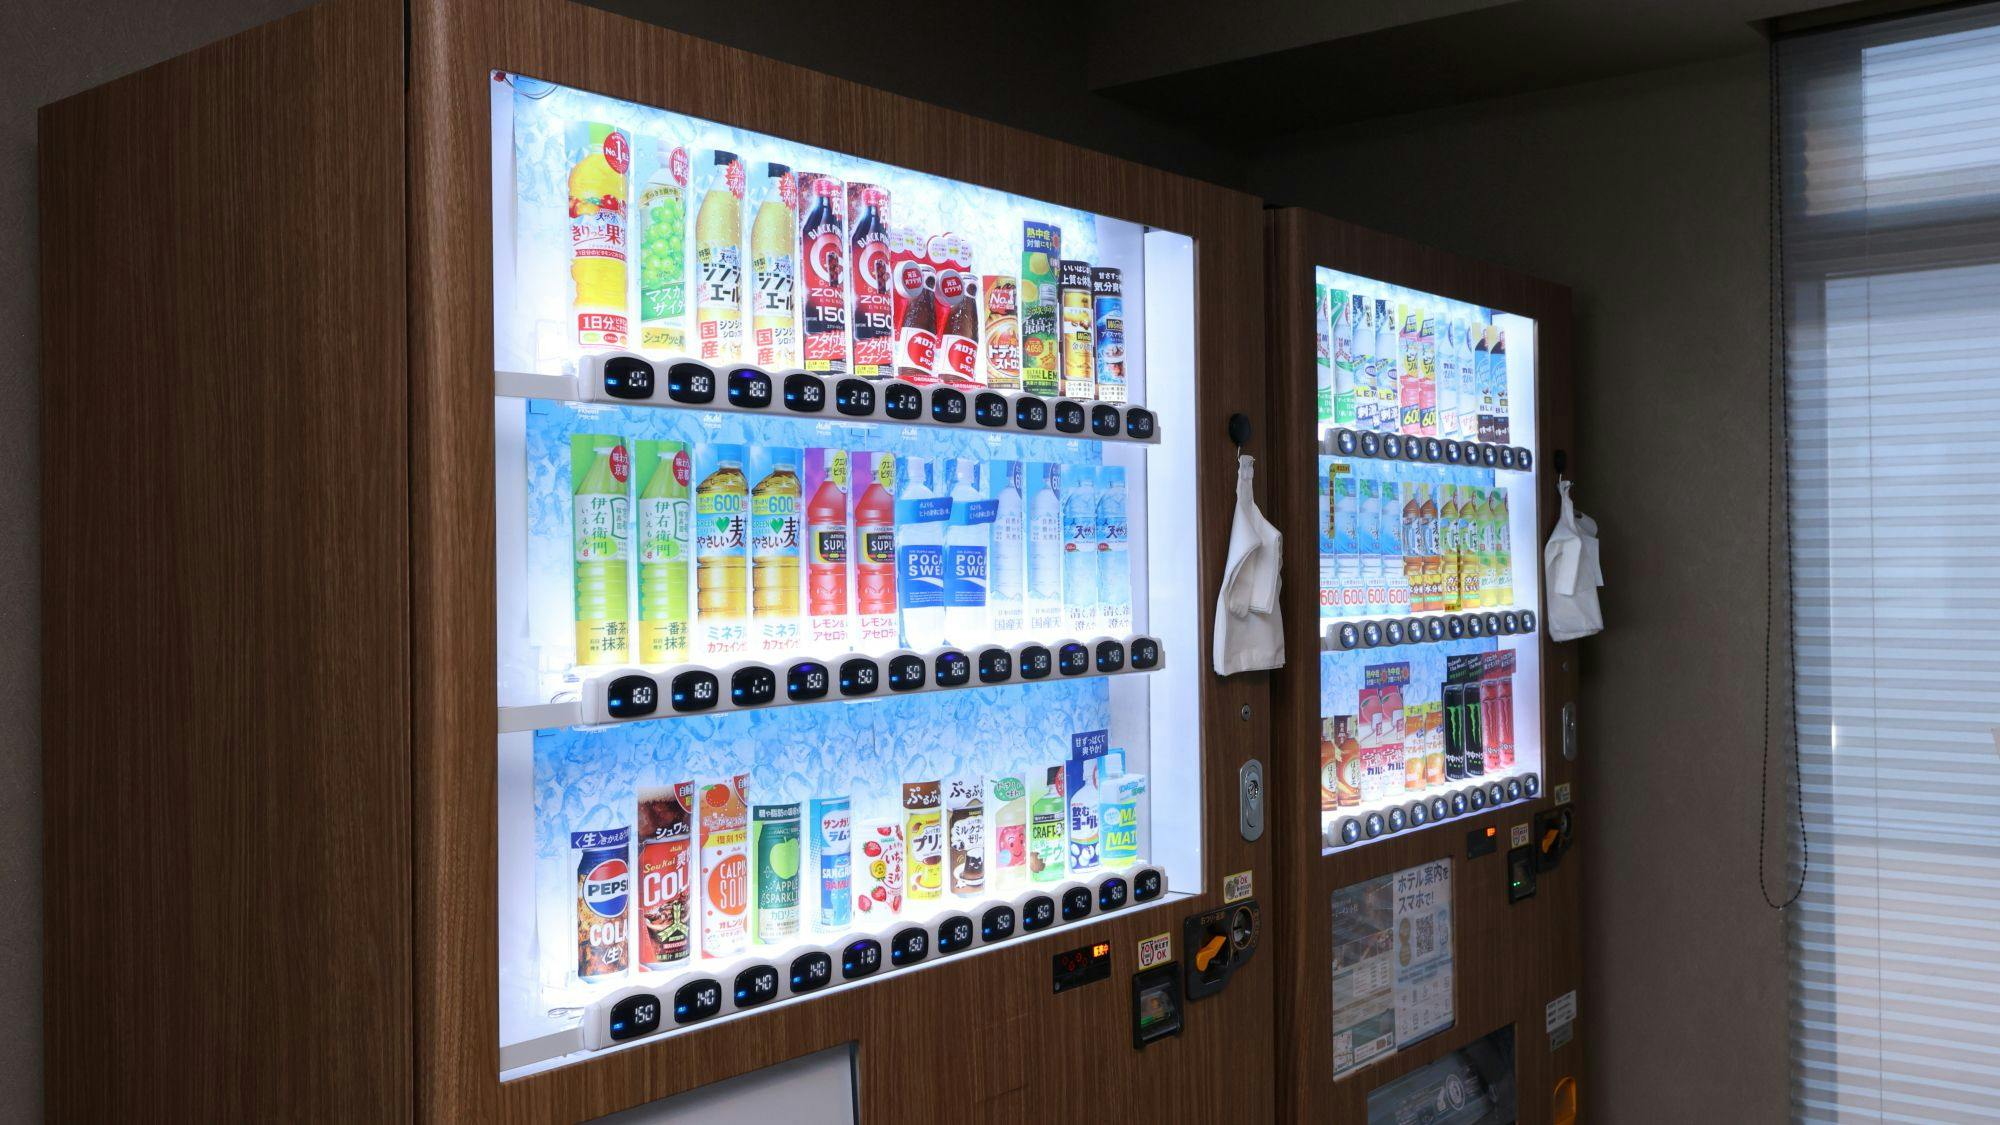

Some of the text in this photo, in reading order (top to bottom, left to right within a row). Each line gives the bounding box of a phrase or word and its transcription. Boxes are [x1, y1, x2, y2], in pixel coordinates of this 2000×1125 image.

[700, 320, 719, 360] 国産
[756, 328, 774, 366] 国産
[851, 390, 869, 406] 210
[899, 395, 916, 410] 210
[713, 494, 740, 512] 600
[768, 495, 794, 513] 600
[591, 497, 608, 554] 伊右衛門
[655, 501, 671, 556] 伊右衛門
[697, 515, 745, 548] やさしい 麦
[752, 516, 798, 548] やさしい 麦
[1388, 589, 1408, 604] 600
[590, 621, 627, 636] 一番茶
[654, 621, 688, 635] 一番茶
[602, 637, 626, 651] 抹茶
[665, 636, 687, 650] 抹茶
[806, 673, 823, 689] 150
[632, 686, 651, 704] 160
[1072, 806, 1090, 818] 飲む
[1239, 874, 1248, 885] OK
[1397, 864, 1449, 893] ホテル案内を
[1398, 891, 1435, 915] スマホで!
[1156, 948, 1167, 960] OK
[809, 961, 825, 979] 140
[755, 974, 772, 992] 140
[697, 988, 714, 1008] 140
[635, 1004, 654, 1024] 150
